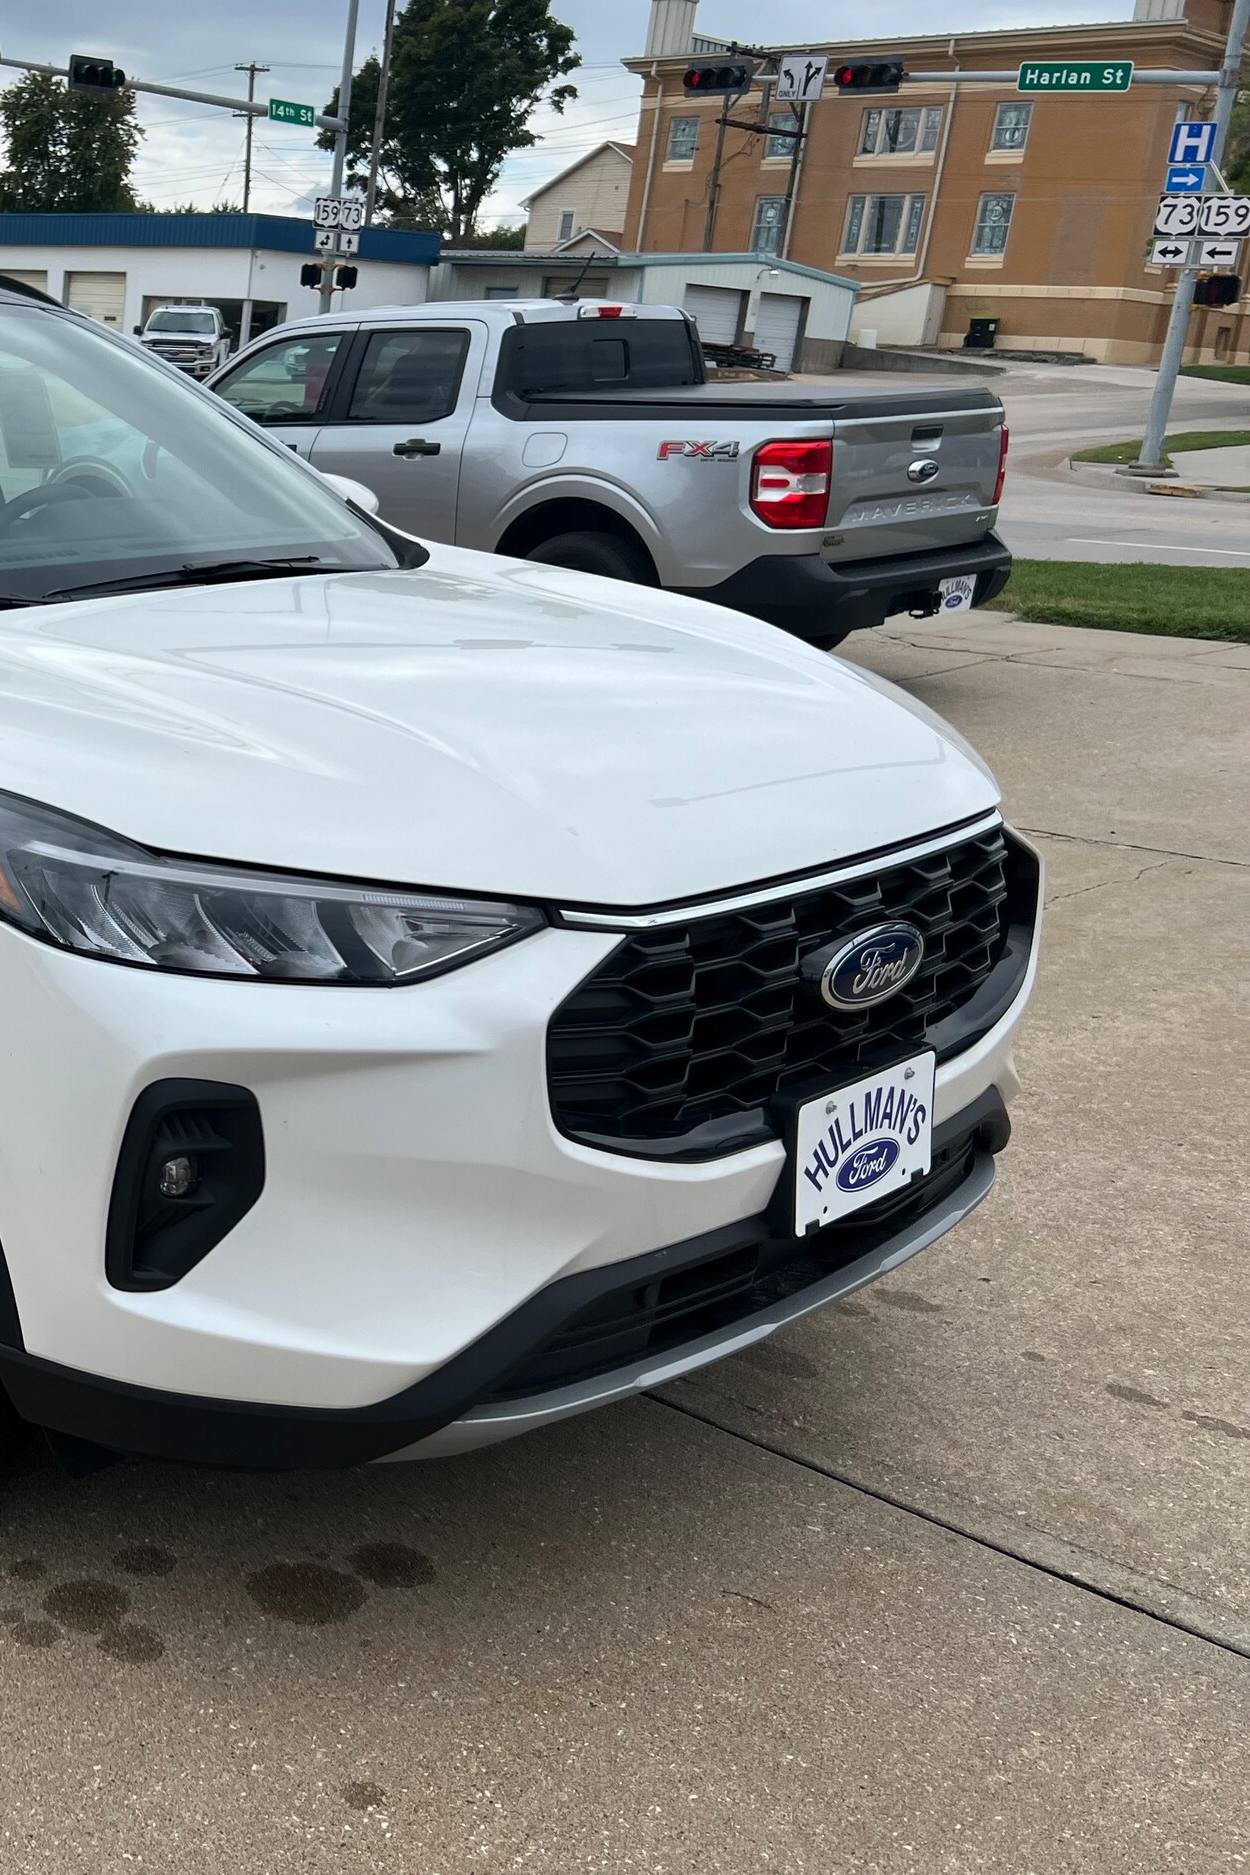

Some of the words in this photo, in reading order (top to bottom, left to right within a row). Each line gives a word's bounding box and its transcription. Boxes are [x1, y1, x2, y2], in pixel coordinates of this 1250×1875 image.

[1025, 69, 1091, 85] Harlan
[1102, 68, 1124, 84] St
[778, 90, 796, 98] ONLY
[271, 104, 295, 118] 14th
[300, 109, 312, 122] St
[1174, 125, 1212, 161] H
[315, 203, 339, 221] 159
[344, 206, 361, 224] 73
[1163, 203, 1196, 226] 73
[1204, 204, 1250, 226] 159
[657, 440, 740, 461] FX4
[852, 494, 972, 522] MAVERICK
[852, 942, 909, 995] Ford
[804, 1085, 927, 1193] HULLMAN'S
[849, 1145, 889, 1185] Ford
